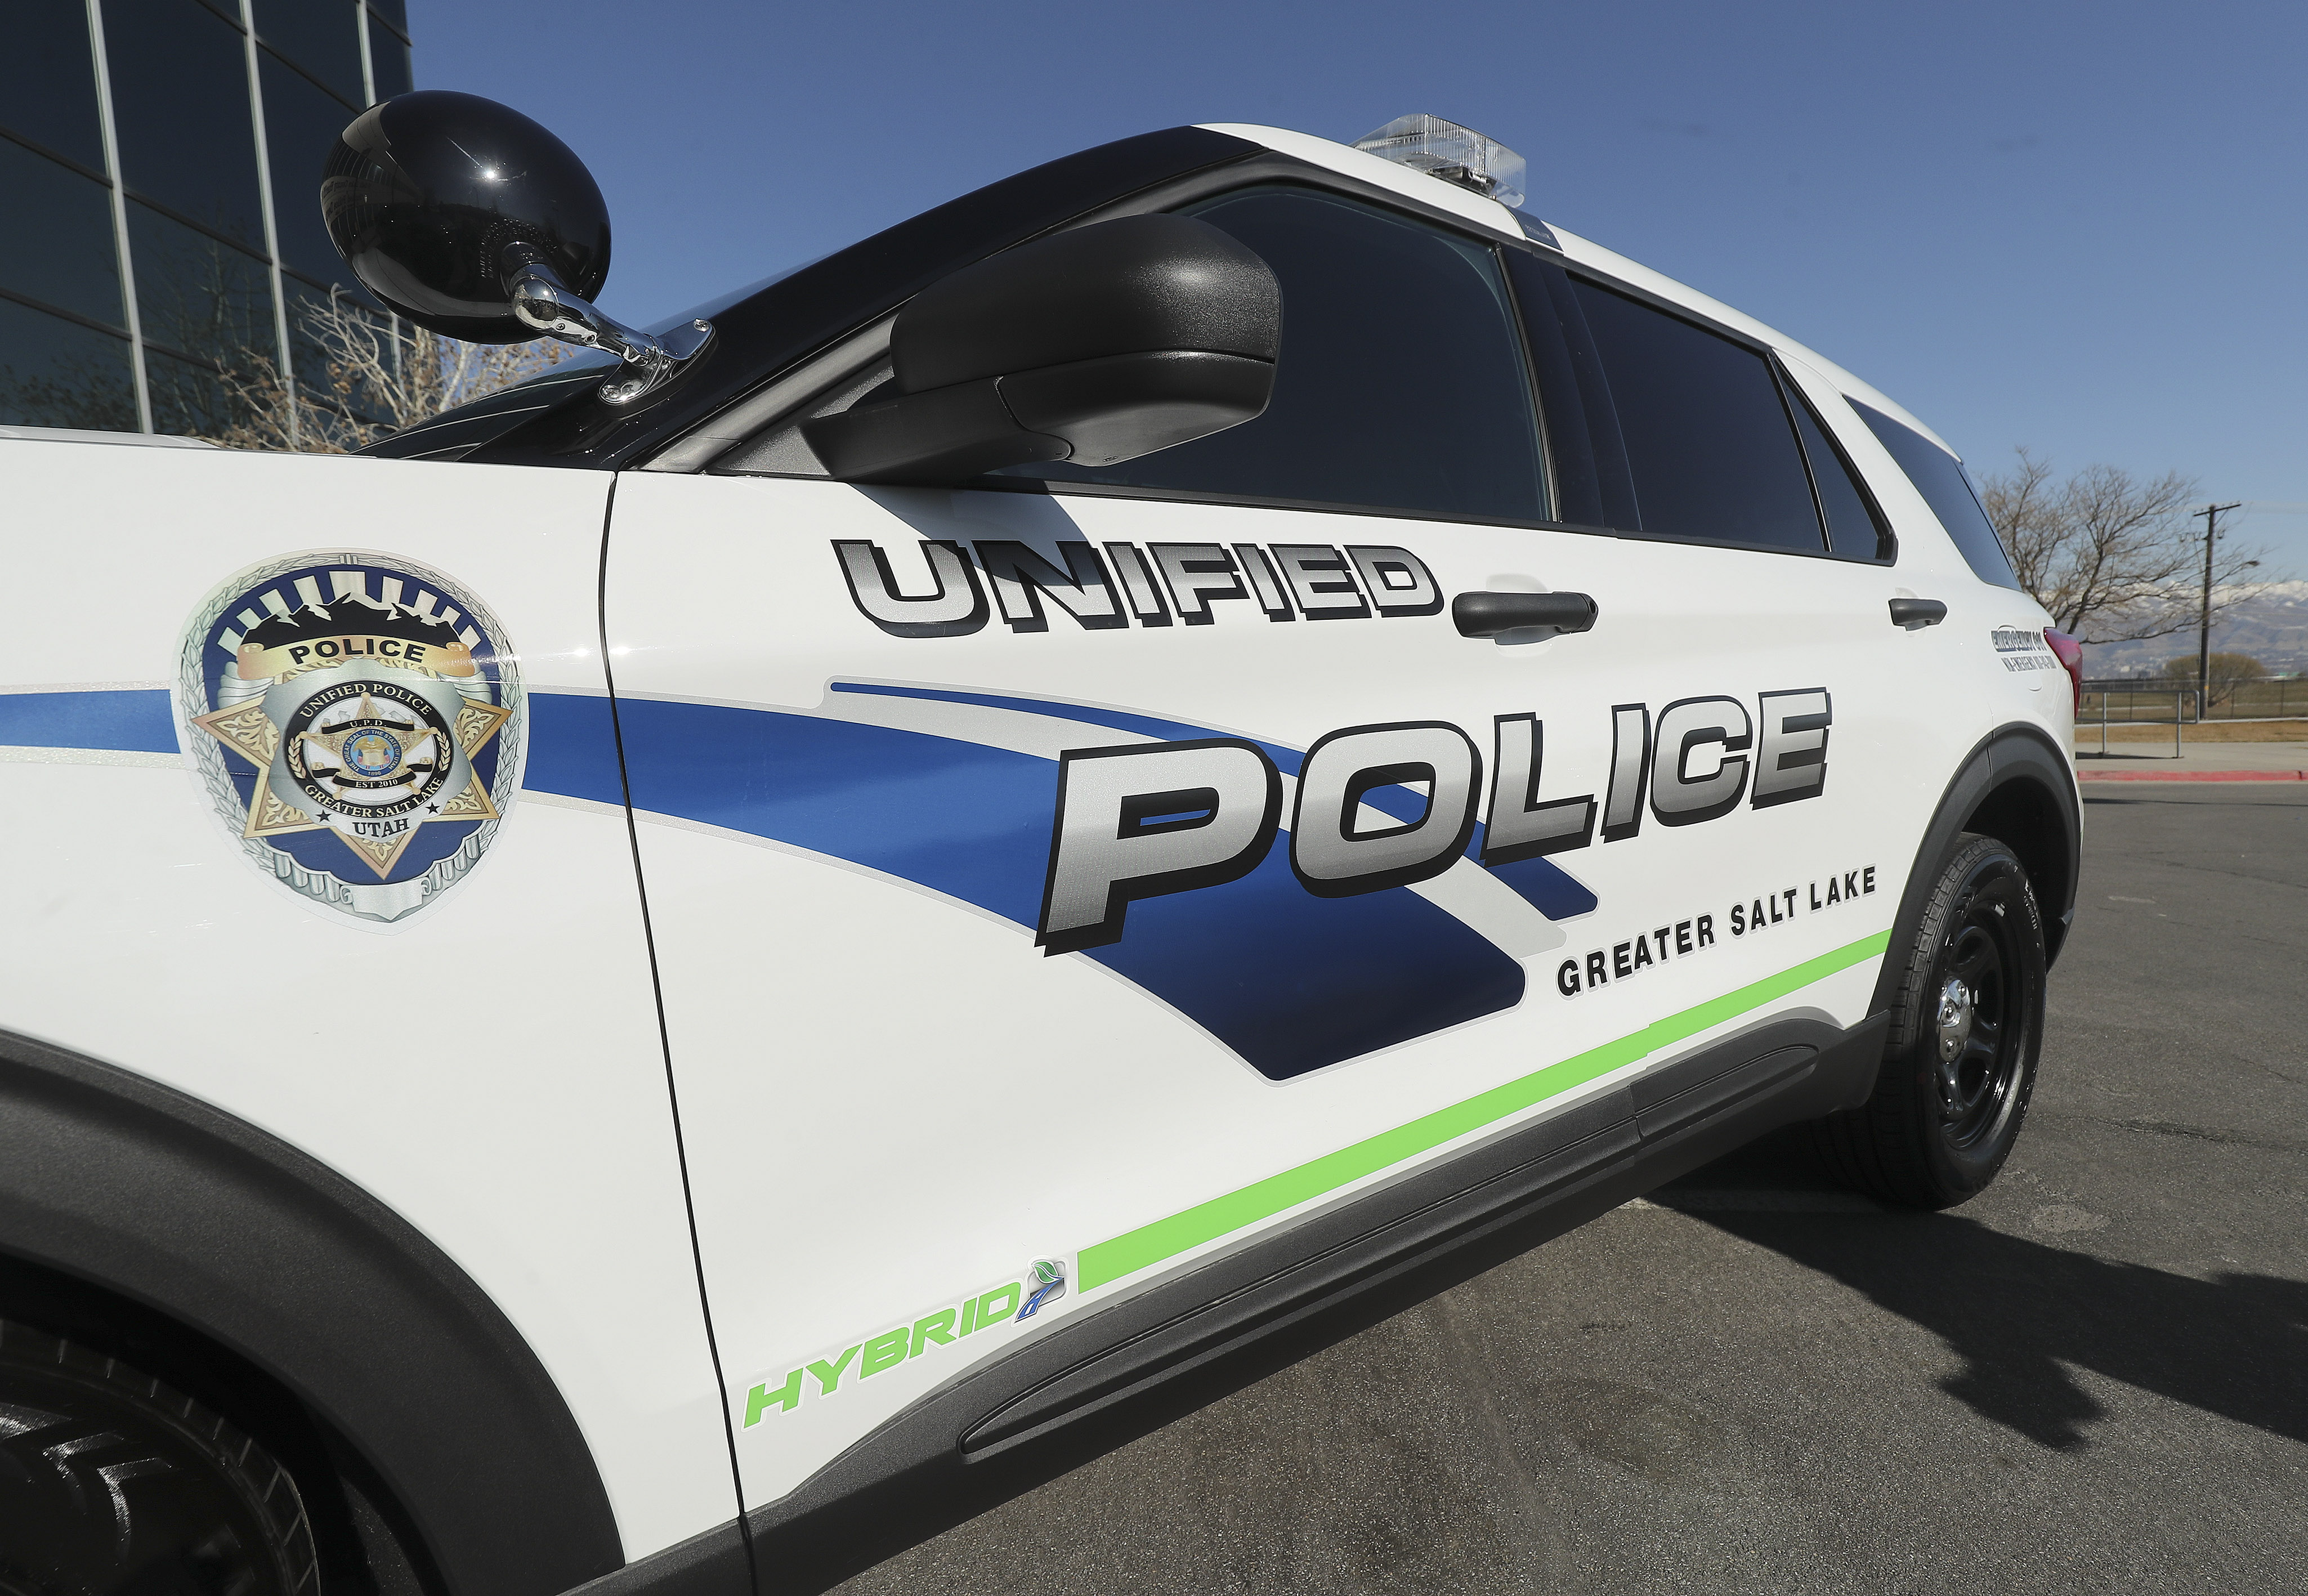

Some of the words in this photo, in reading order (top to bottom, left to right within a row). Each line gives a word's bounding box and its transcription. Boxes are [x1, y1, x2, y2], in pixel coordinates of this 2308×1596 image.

[830, 540, 1444, 638] UNIFIED
[289, 639, 426, 664] POLICE
[300, 683, 367, 718] UNIFIED
[372, 683, 432, 716] POLICE
[347, 733, 361, 744] SEAL
[384, 733, 399, 748] STATE
[349, 763, 360, 772] THE
[388, 757, 399, 770] UTAH
[378, 779, 398, 788] 2010
[305, 785, 372, 817] GREATER
[376, 801, 411, 817] SALT
[413, 777, 443, 806] LAKE
[352, 818, 410, 838] UTAH
[1034, 687, 1832, 956] POLICE
[1558, 914, 1715, 996] GREATER
[1730, 888, 1797, 936] SALT
[1810, 866, 1876, 911] LAKE
[744, 1282, 1021, 1429] HYBRID
